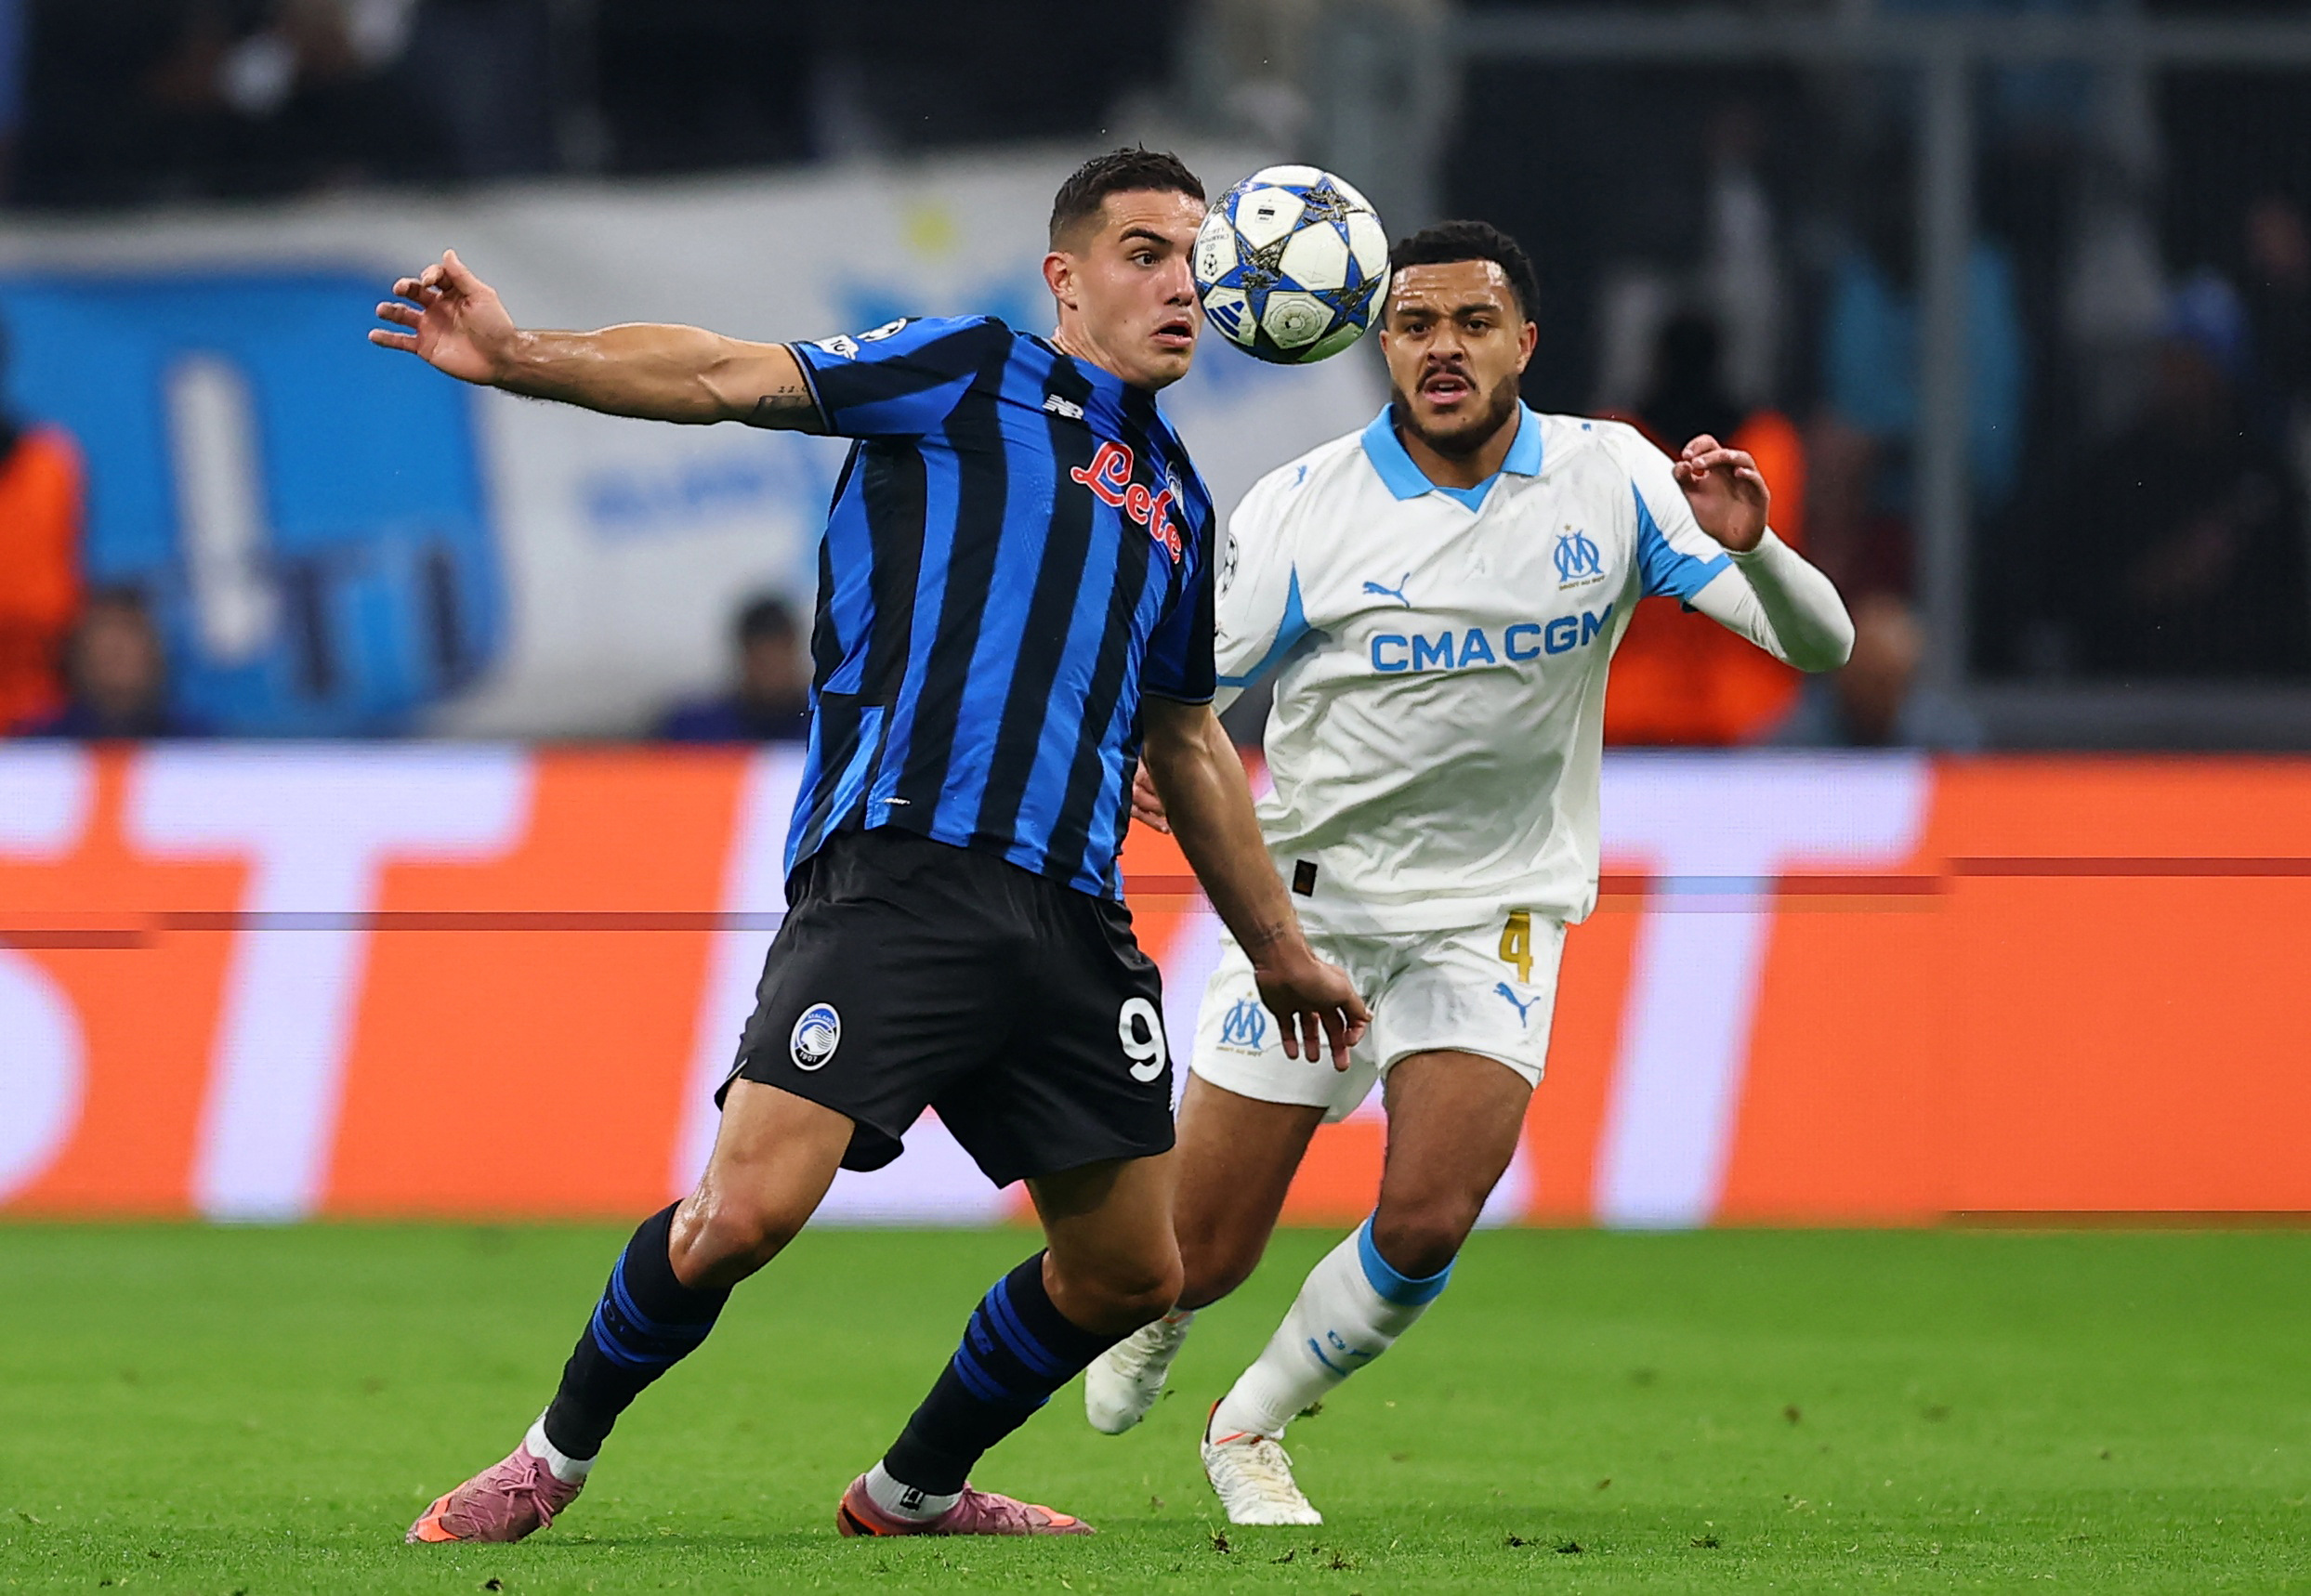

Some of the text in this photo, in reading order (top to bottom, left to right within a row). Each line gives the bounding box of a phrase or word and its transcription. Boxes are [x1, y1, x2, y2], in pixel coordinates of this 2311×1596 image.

[1070, 441, 1183, 565] Lete
[1371, 604, 1613, 672] CMA CGM
[1499, 909, 1534, 985] 4
[1118, 997, 1166, 1082] 9
